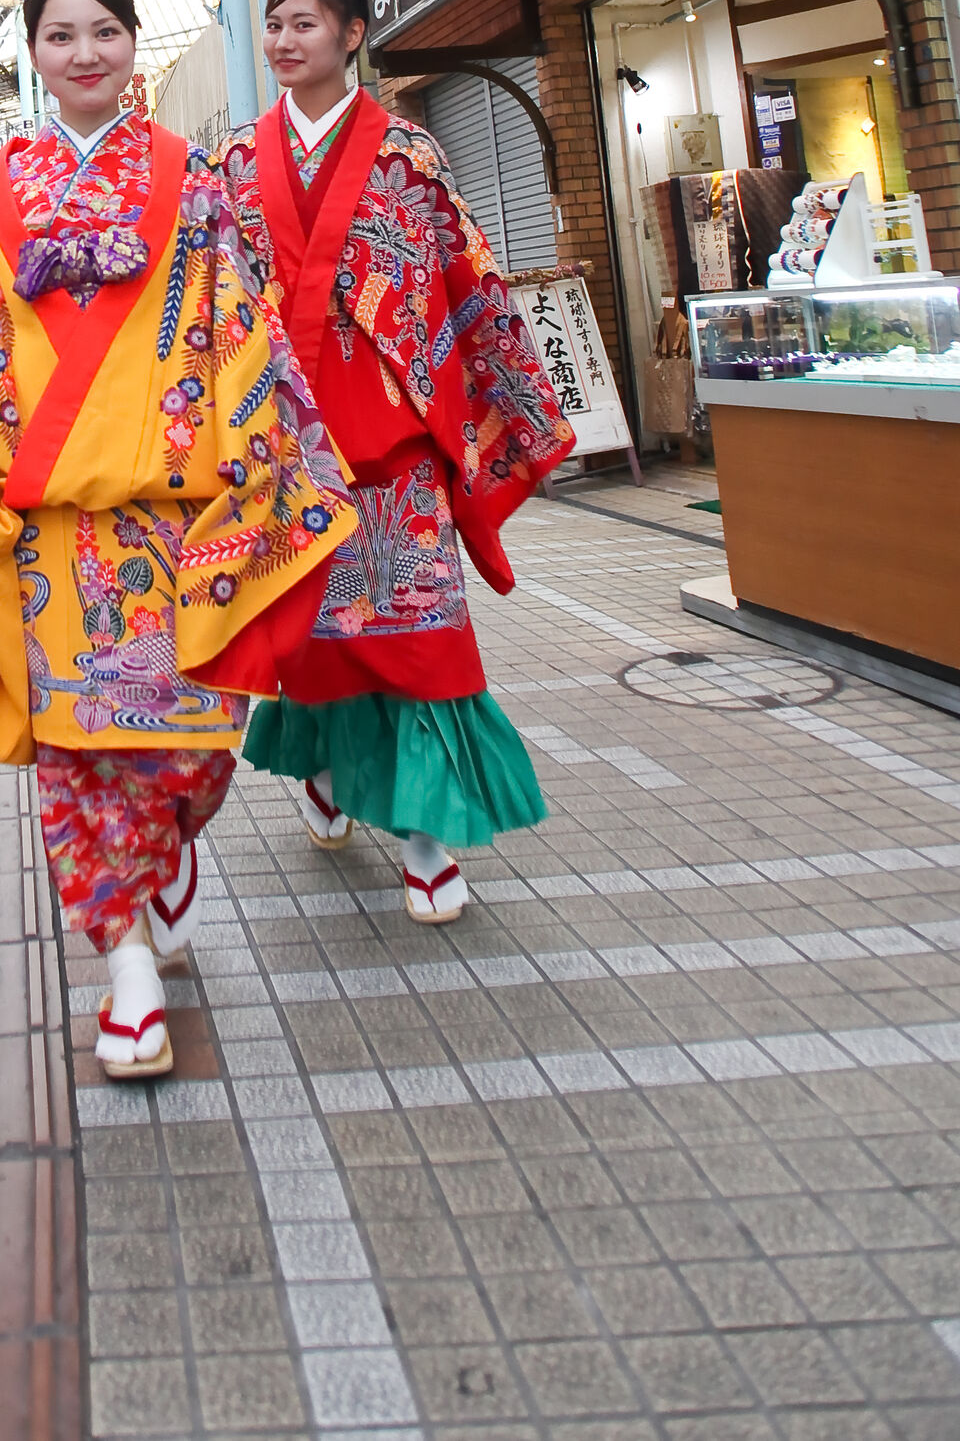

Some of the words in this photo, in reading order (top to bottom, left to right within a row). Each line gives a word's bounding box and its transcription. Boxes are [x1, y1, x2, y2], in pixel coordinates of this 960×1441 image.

[776, 99, 791, 107] VISA
[23, 120, 34, 129] B
[532, 292, 584, 410] よへな商店
